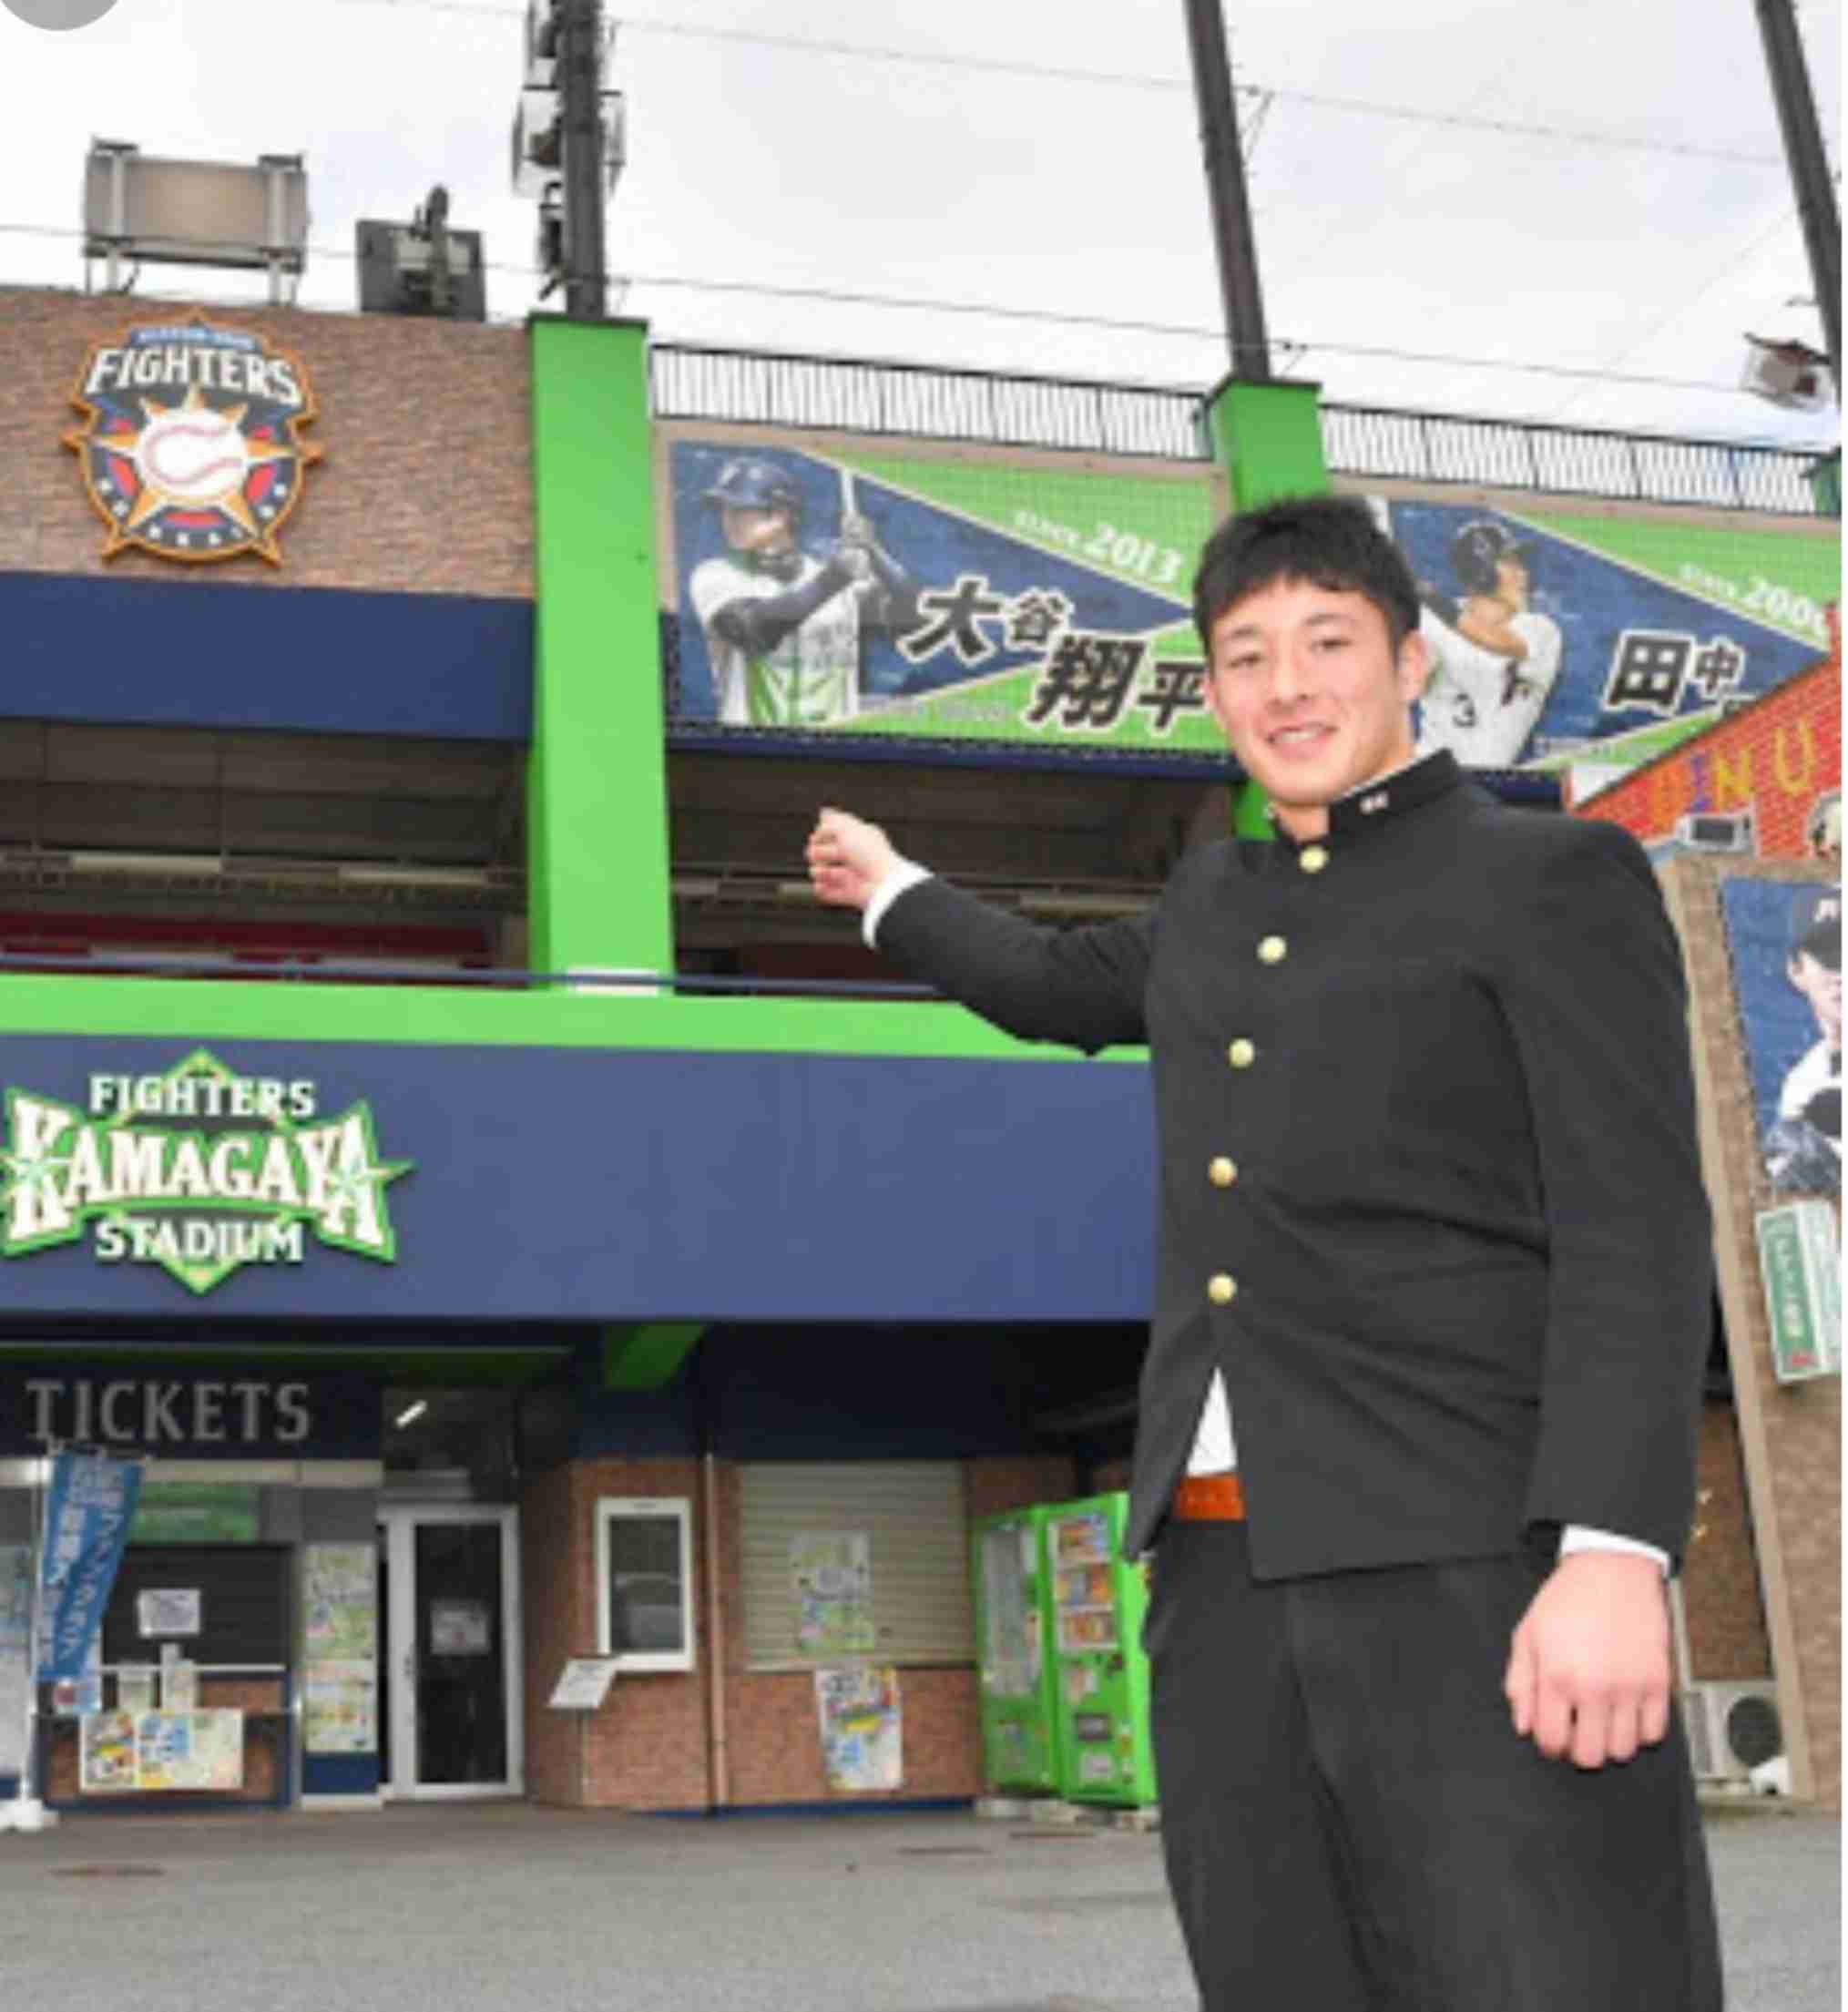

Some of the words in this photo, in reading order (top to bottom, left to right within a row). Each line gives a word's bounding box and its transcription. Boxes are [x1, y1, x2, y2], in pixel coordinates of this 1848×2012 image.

[86, 345, 301, 407] FIGHTERS
[1084, 524, 1182, 584] 2013
[1606, 632, 1745, 710] 田中
[90, 1075, 317, 1118] FIGHTERS
[9, 1097, 384, 1247] KAMAGAYA
[94, 1217, 305, 1262] STADIUM
[26, 1379, 311, 1441] TICKETS
